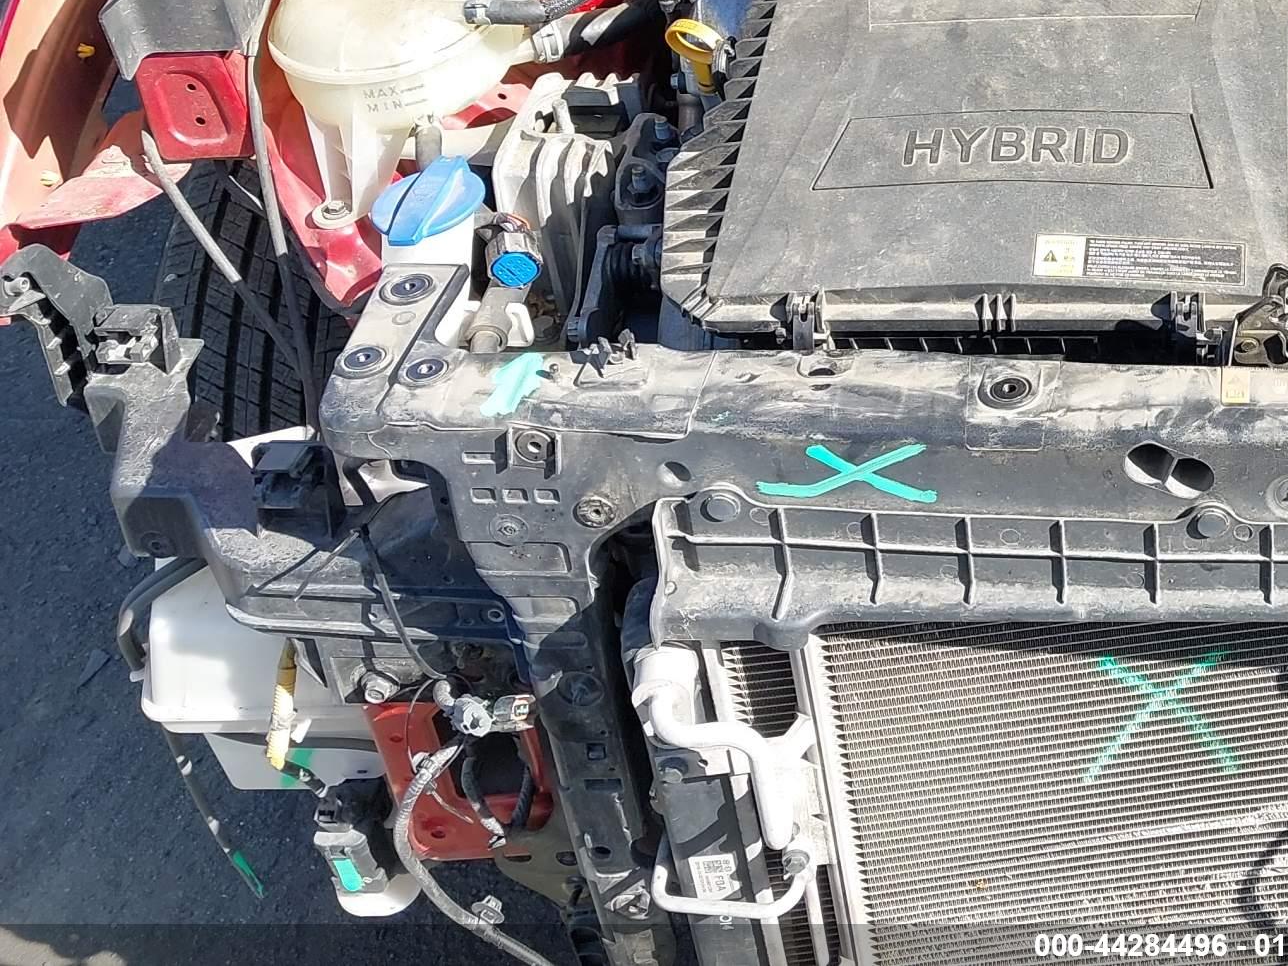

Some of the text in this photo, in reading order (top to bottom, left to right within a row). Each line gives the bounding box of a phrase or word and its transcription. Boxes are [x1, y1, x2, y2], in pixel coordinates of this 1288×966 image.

[363, 85, 400, 99] MAX
[366, 99, 402, 113] MIN
[902, 126, 1130, 166] HYBRID
